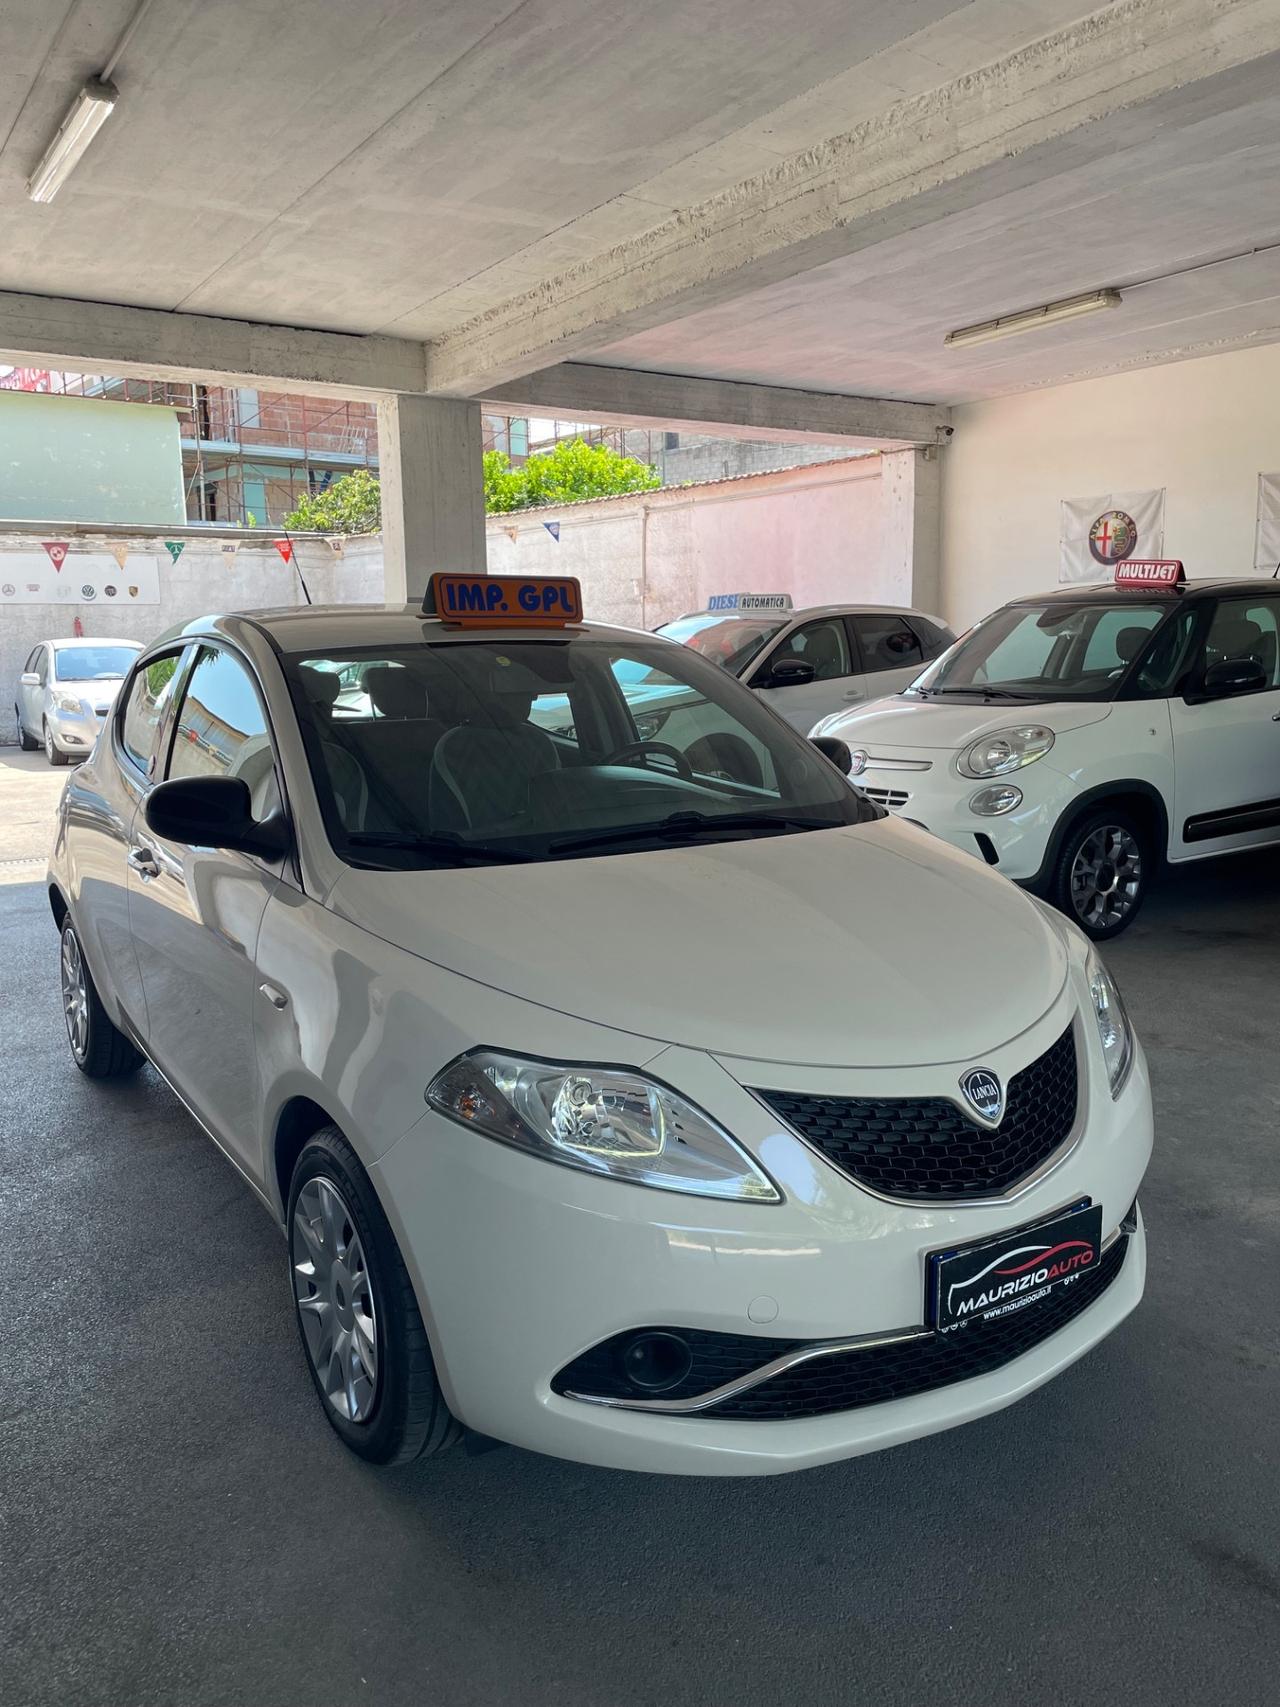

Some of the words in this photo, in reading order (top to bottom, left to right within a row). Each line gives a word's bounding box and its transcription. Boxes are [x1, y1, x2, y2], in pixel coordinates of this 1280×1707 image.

[1118, 563, 1175, 580] MULTIJET
[446, 583, 508, 612] IMP.
[518, 585, 573, 612] GPL
[741, 597, 785, 609] AUTOMATICA
[983, 1285, 1052, 1320] www.maurizioauto.it
